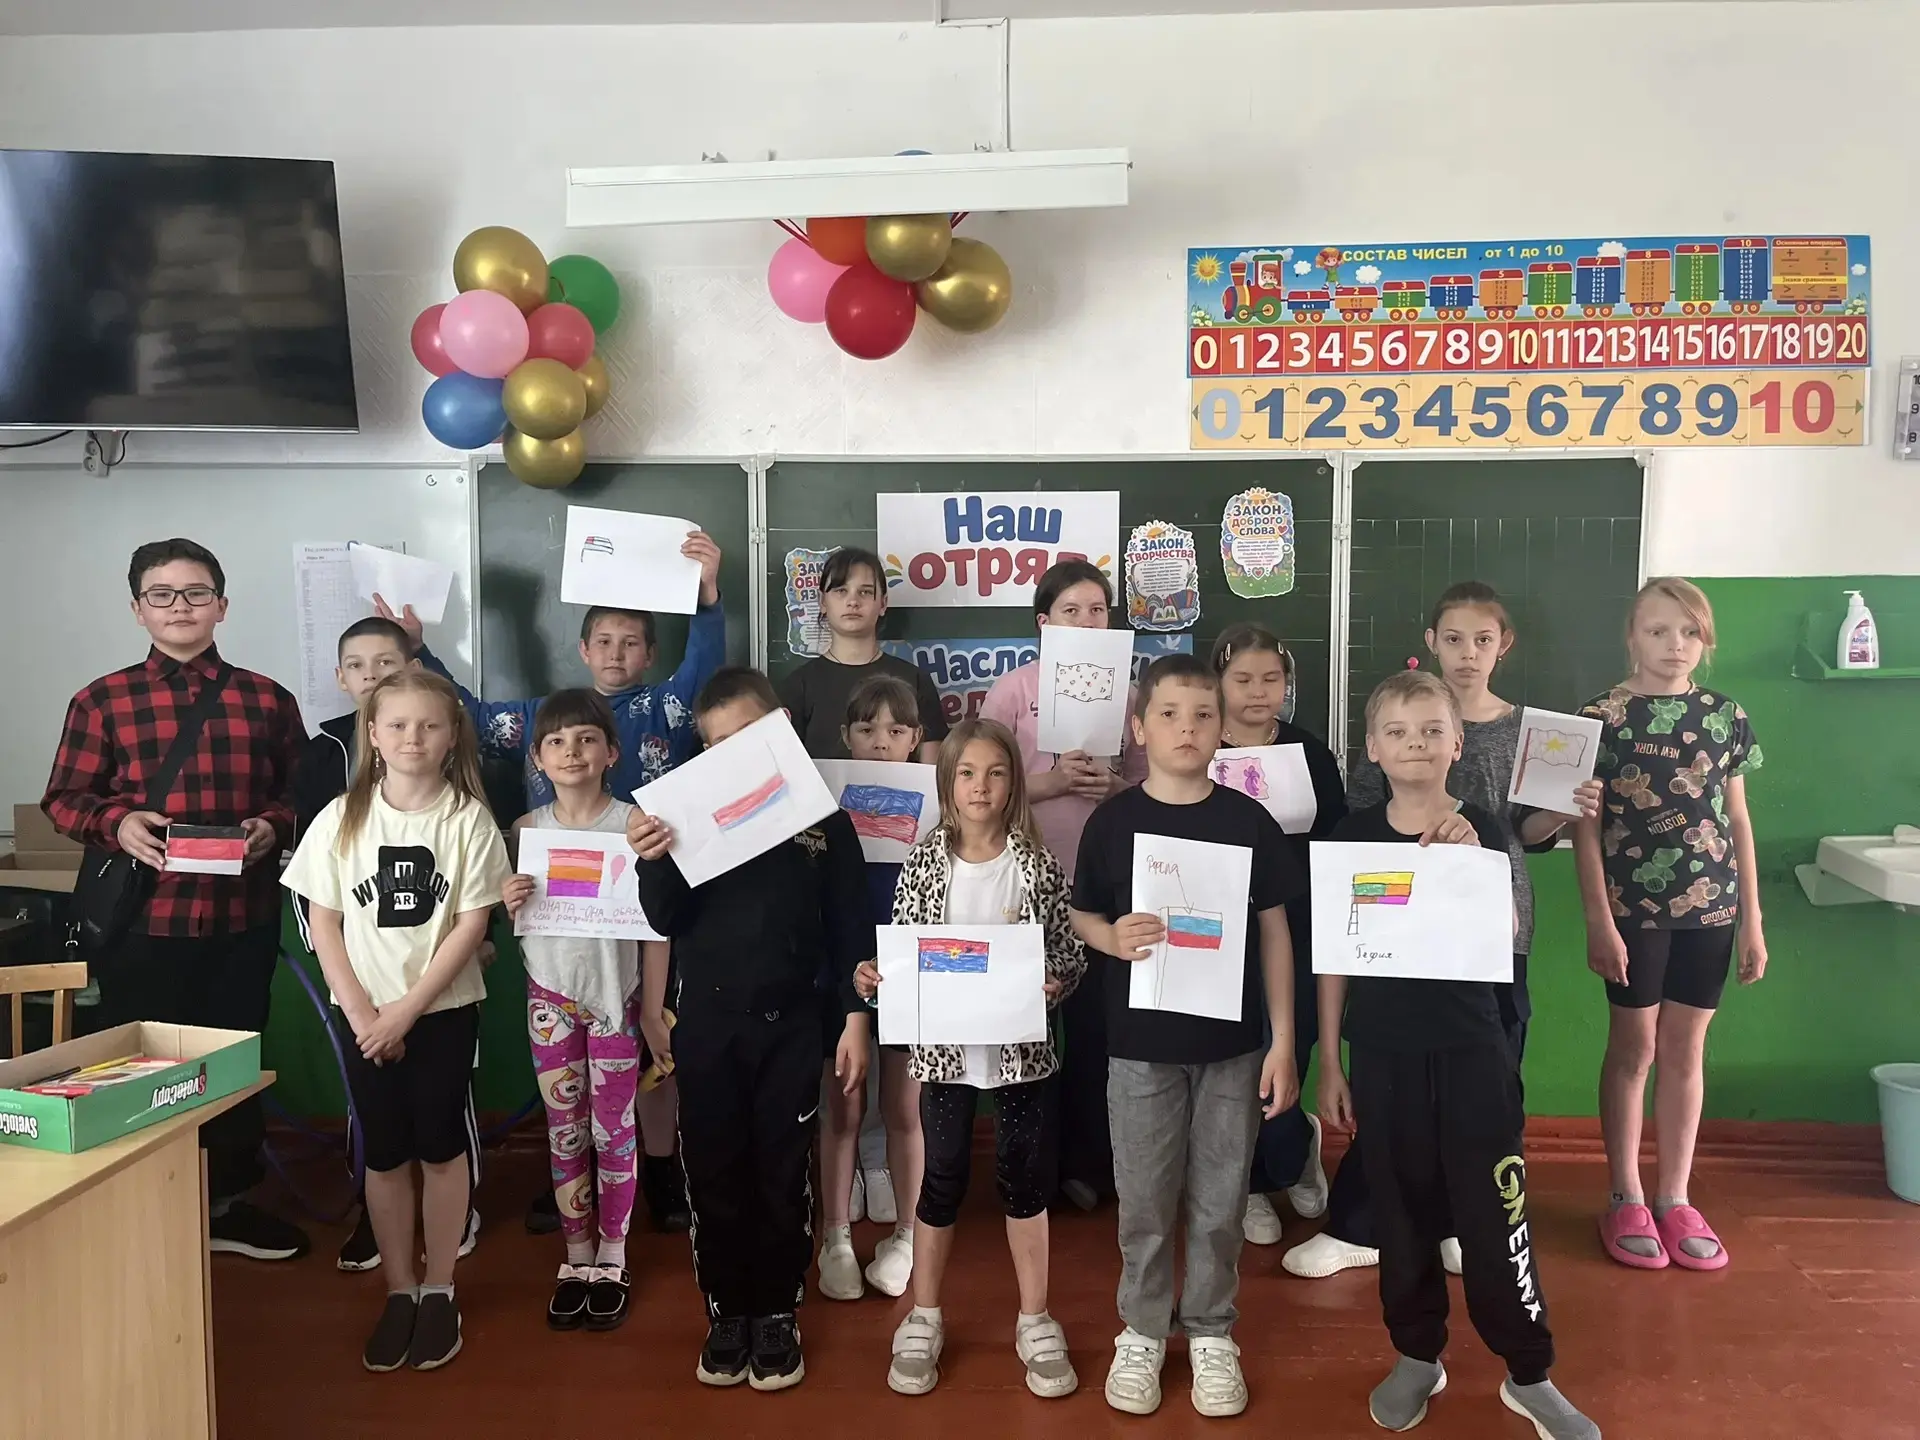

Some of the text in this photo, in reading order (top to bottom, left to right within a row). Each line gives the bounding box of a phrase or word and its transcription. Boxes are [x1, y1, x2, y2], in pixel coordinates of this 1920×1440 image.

[1342, 245, 1564, 262] СОСТАВ ЧИСЕЛ от 1 до 10
[1193, 323, 1867, 369] 0 1 2 3 4 5 6 7 8 9 10 11 12 13 14 15 16 17 18 19 20
[1200, 380, 1835, 439] 0 1 2 3 4 5 6 7 8 9 10
[1911, 404, 1919, 414] 9
[1909, 432, 1917, 442] 8
[1233, 505, 1281, 516] ЗАКОН
[943, 496, 1062, 544] Наш
[1232, 517, 1283, 527] доброго
[1239, 526, 1275, 536] слова
[1139, 538, 1184, 551] ЗАКОН
[1127, 550, 1194, 564] Творчества
[797, 562, 824, 576] ЗАК
[908, 546, 1088, 596] отря
[1633, 742, 1680, 759] NEW YORK
[1648, 813, 1687, 835] BOSTON
[0, 1112, 38, 1139] SvetoCo
